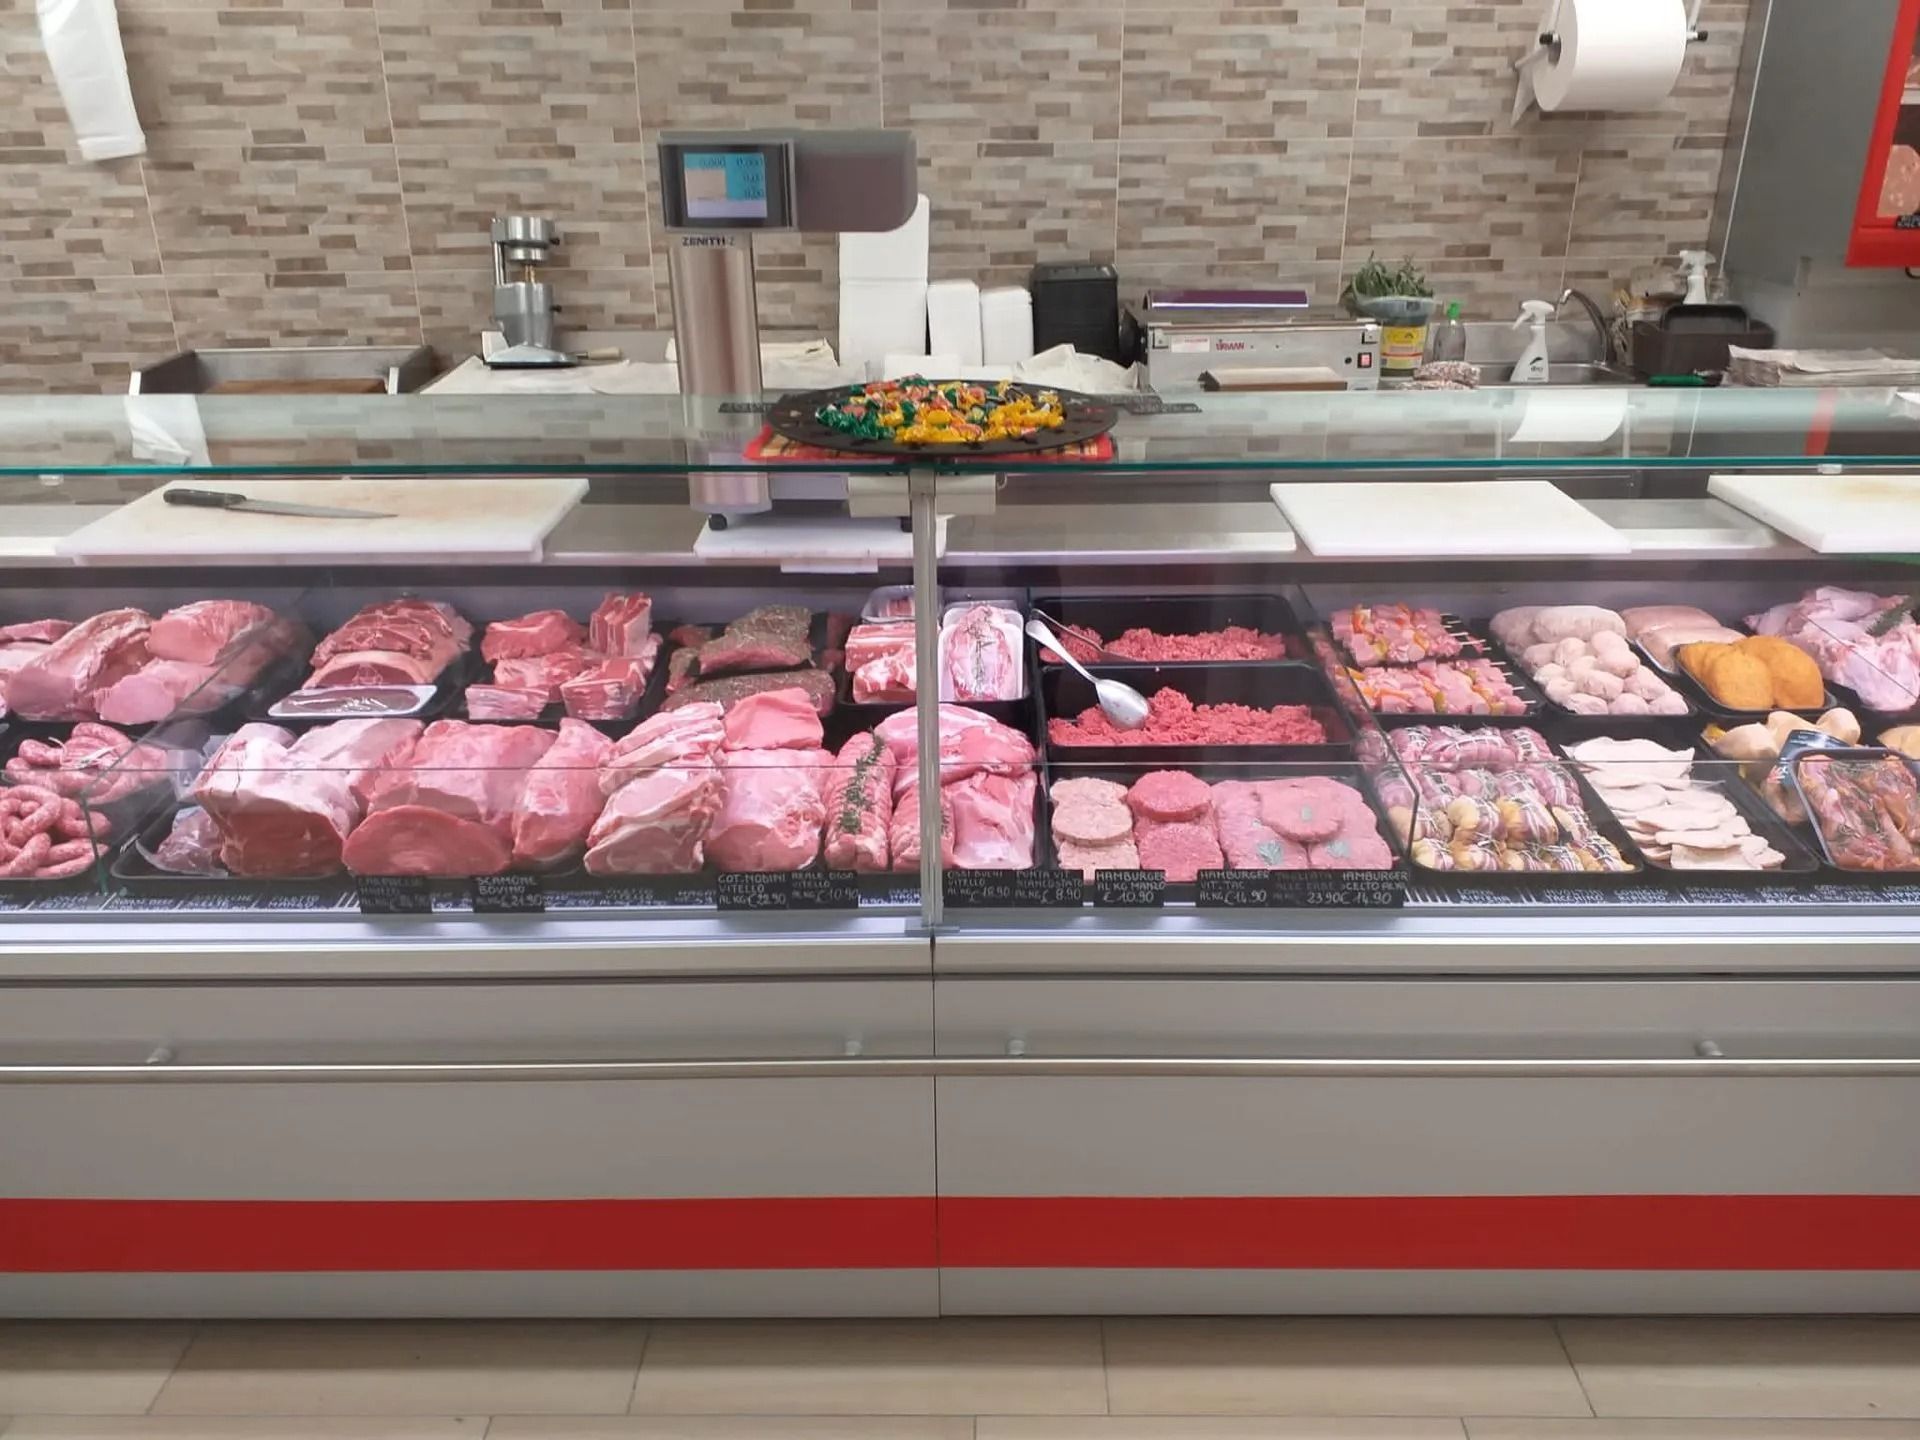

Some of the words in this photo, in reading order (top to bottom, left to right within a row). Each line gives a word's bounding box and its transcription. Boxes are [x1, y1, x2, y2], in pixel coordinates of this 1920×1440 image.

[1096, 871, 1166, 881] HAMBURGER
[1200, 870, 1269, 880] HAMBURGER
[1097, 882, 1110, 891] AL
[1113, 882, 1128, 891] KG
